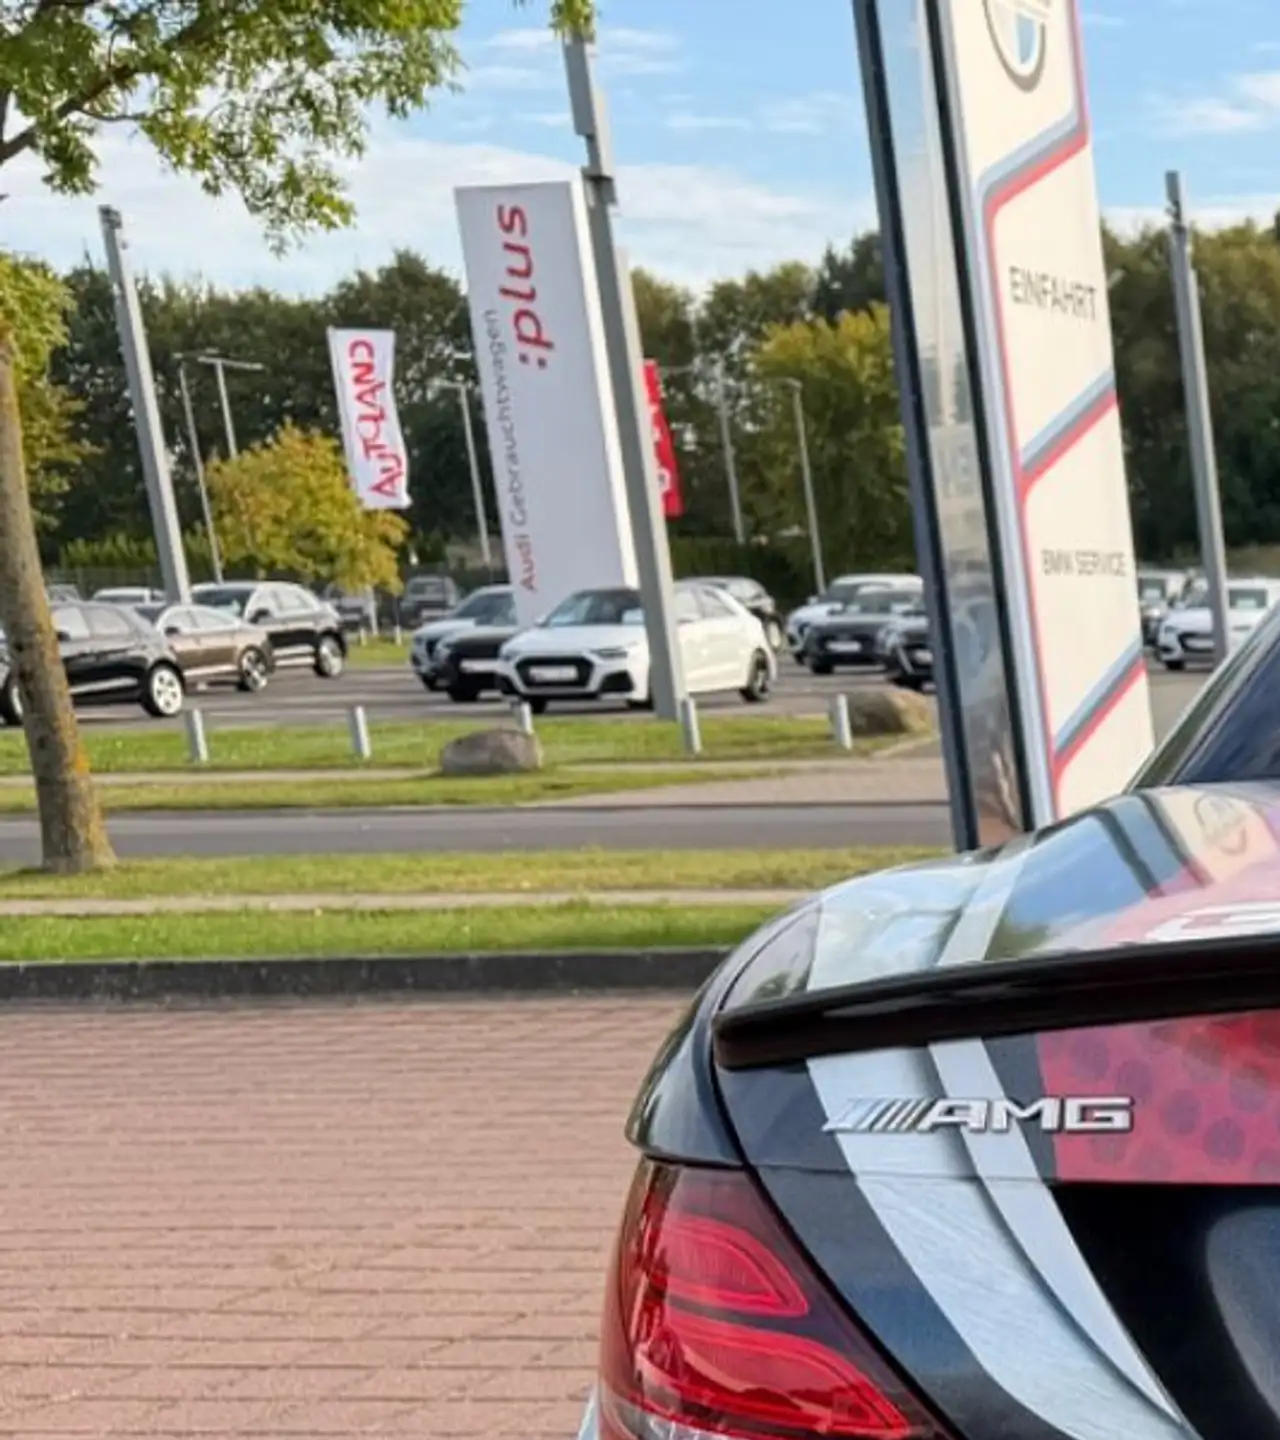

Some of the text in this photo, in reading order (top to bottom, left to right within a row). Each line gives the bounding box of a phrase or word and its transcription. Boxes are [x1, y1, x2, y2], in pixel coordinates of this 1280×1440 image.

[1009, 265, 1099, 322] EINFAHRT
[485, 309, 536, 592] Audi Gebrauchtwagen
